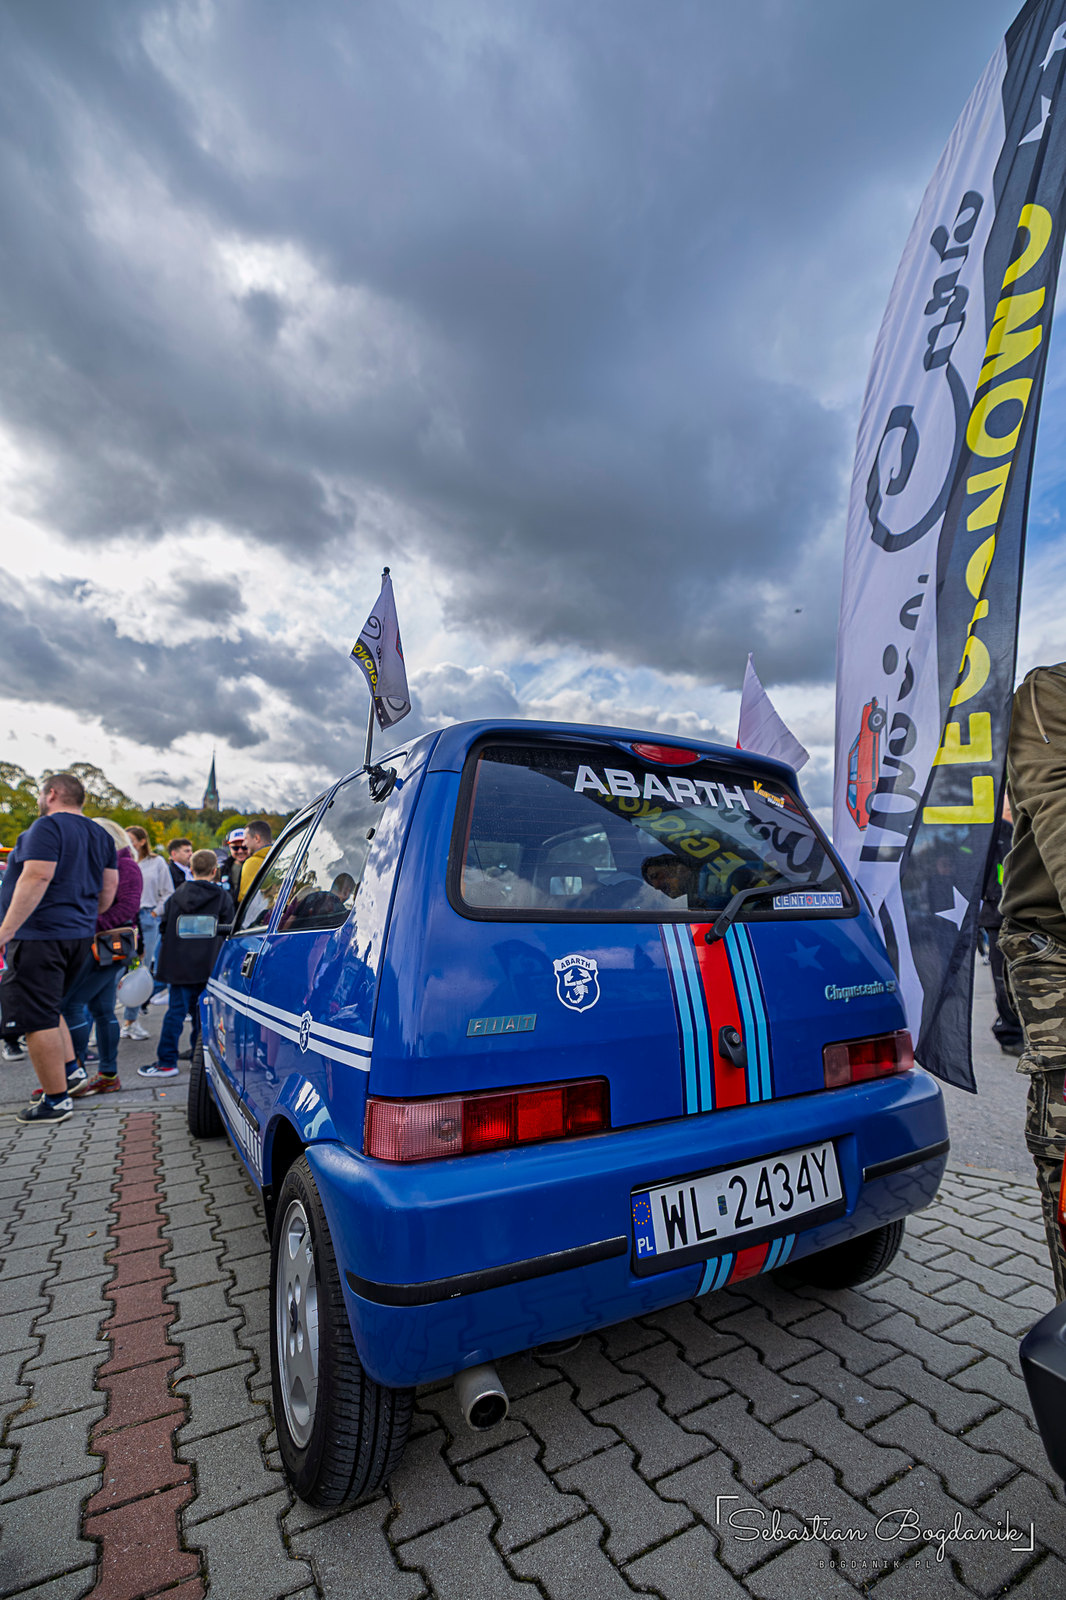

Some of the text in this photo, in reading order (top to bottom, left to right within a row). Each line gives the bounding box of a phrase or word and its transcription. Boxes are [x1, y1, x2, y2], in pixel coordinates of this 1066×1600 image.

[574, 765, 751, 811] ABARTH
[774, 894, 842, 906] CENTOLAND
[560, 957, 591, 969] ABARTH
[824, 980, 885, 1003] Cinquecento
[474, 1016, 532, 1033] FIAT
[660, 1148, 830, 1250] WL 2434Y
[637, 1236, 654, 1254] PL
